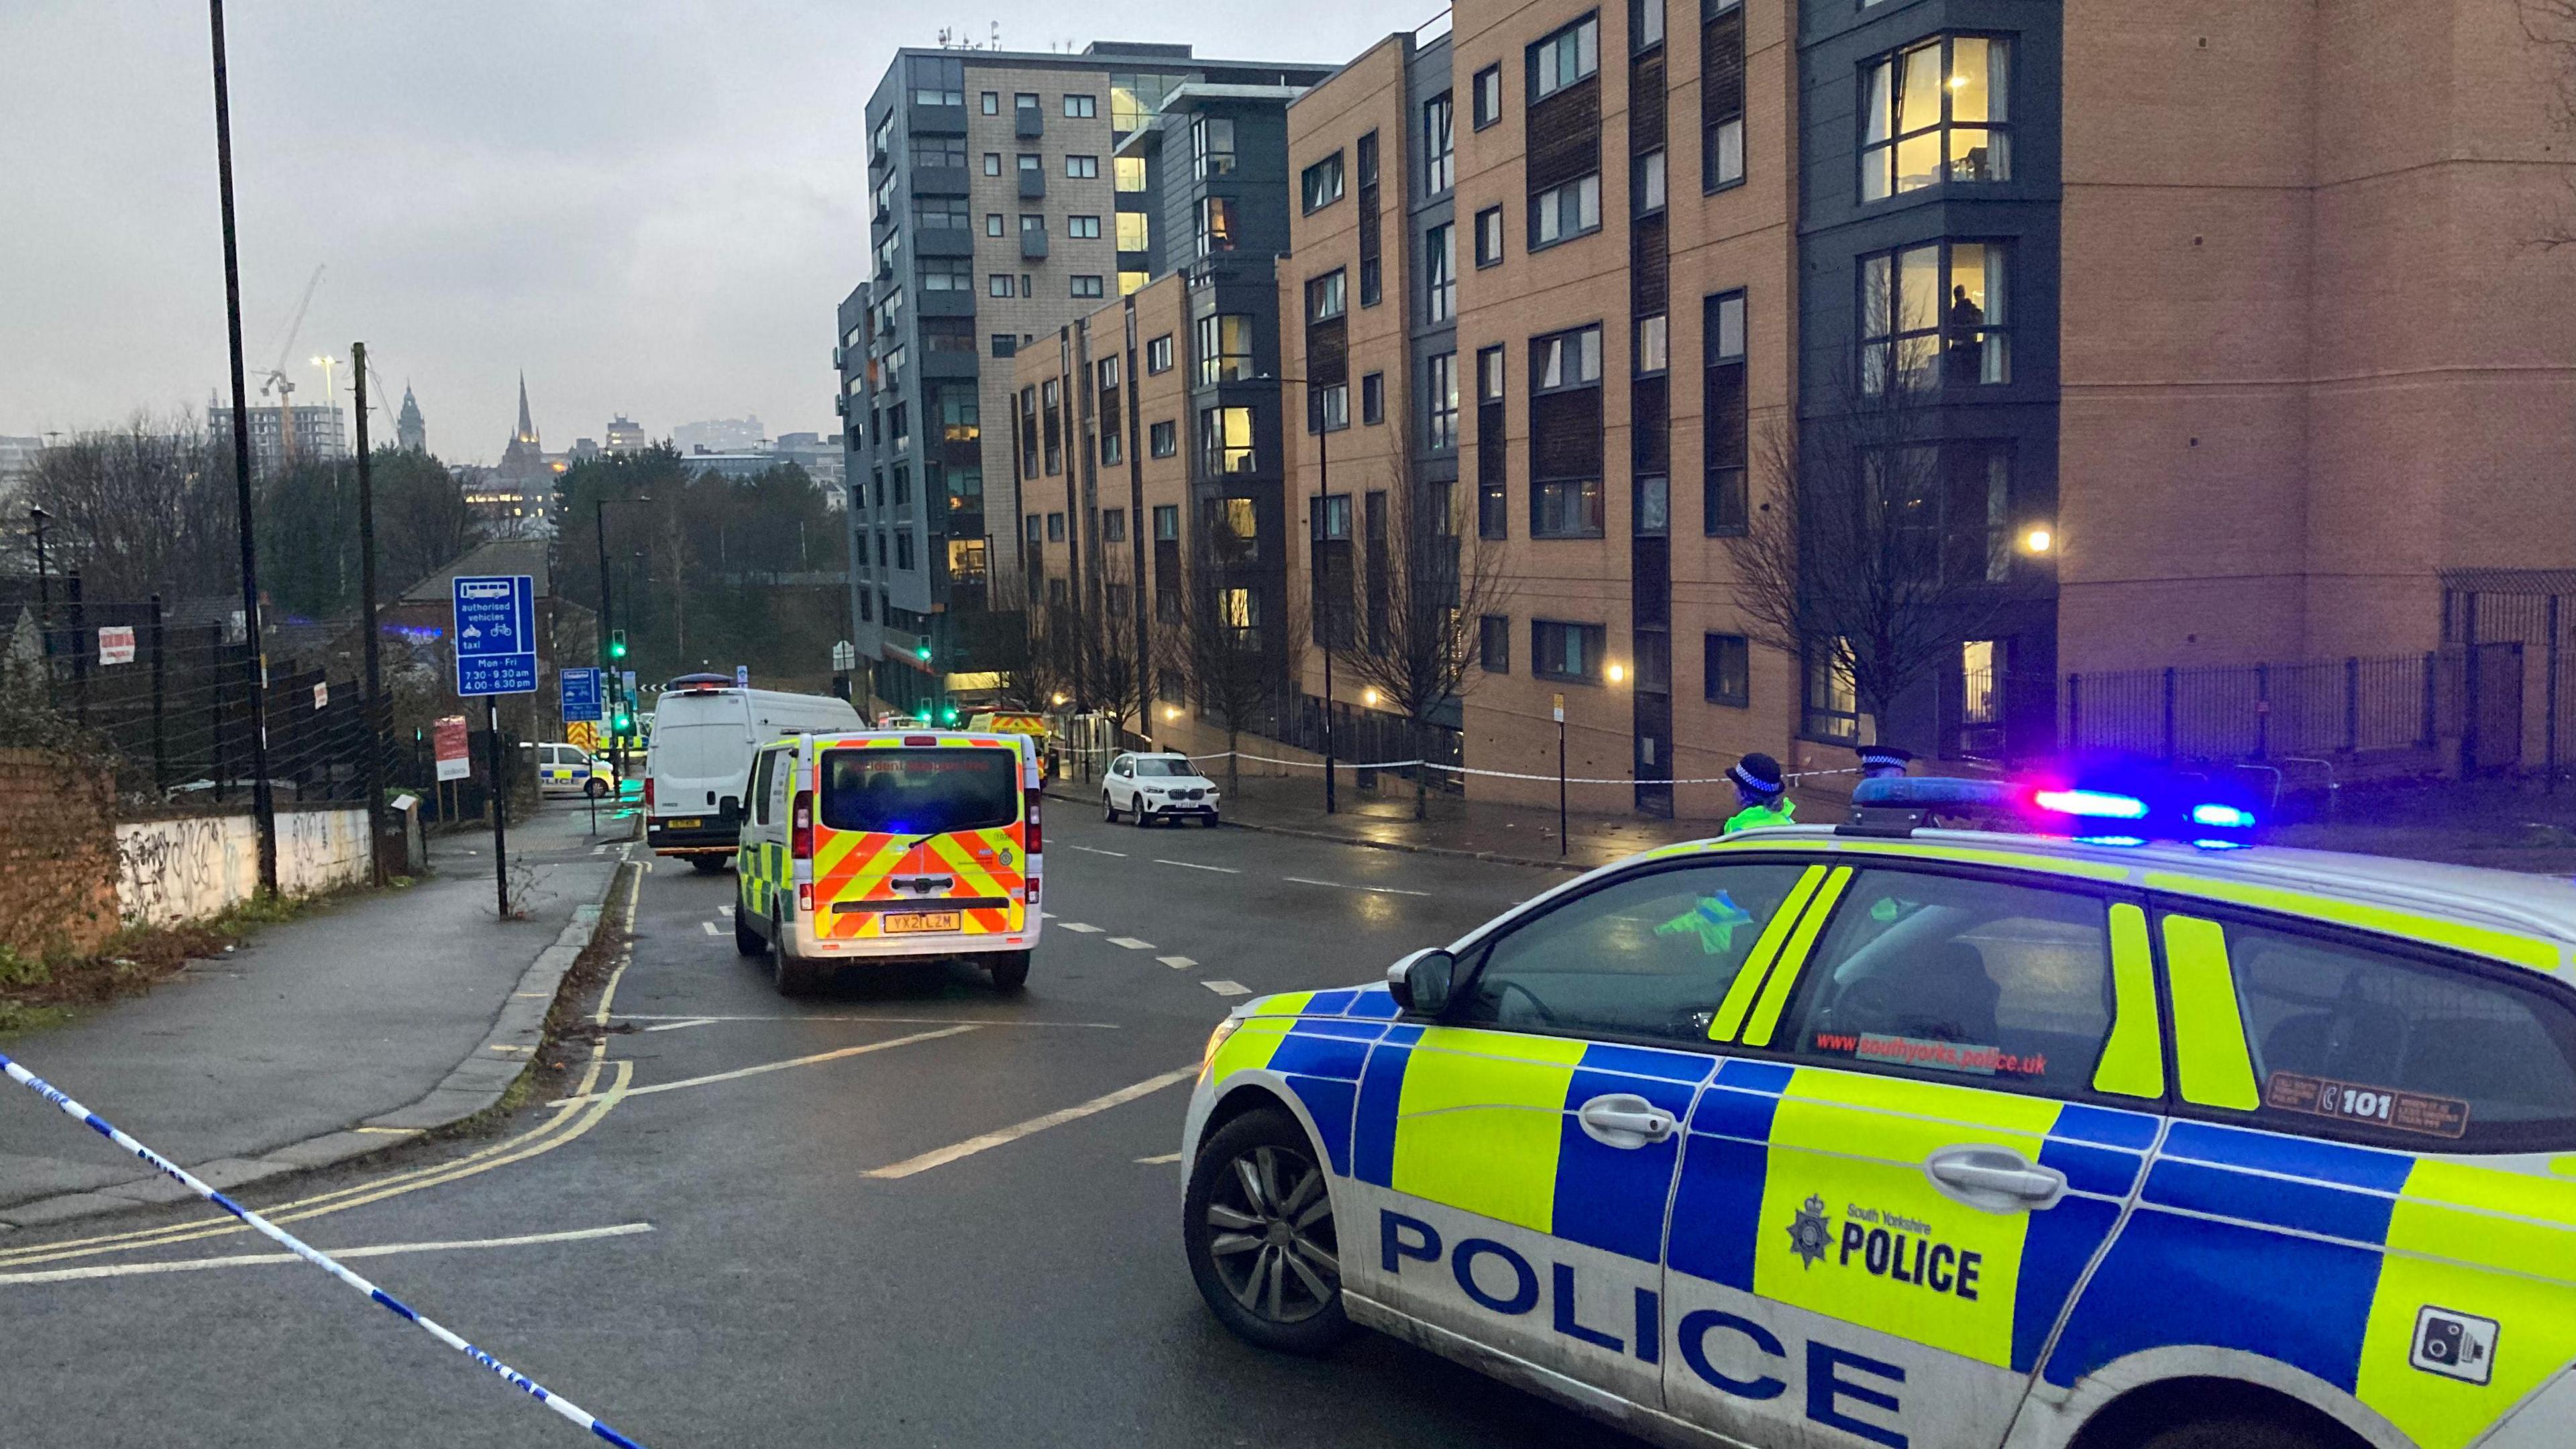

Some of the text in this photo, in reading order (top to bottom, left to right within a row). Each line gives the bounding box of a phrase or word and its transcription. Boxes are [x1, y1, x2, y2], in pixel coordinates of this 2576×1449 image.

[462, 602, 510, 612] authorised
[468, 613, 504, 622] vehicles
[463, 641, 480, 649] taxi
[478, 659, 498, 667] Mon
[505, 658, 517, 666] Fri
[466, 670, 486, 680] 7.30
[492, 669, 515, 678] 9.30
[465, 681, 487, 690] 4.00
[494, 679, 516, 688] 6.30
[517, 680, 531, 688] pm
[894, 915, 951, 929] YX21 LZM
[1816, 1032, 2047, 1075] wwwsouthyorks.police.uk
[2343, 1089, 2392, 1120] 101
[1847, 1203, 1931, 1236] South Yorkshire
[1839, 1221, 1982, 1301] POLICE
[1380, 1208, 1909, 1449] POLICE
